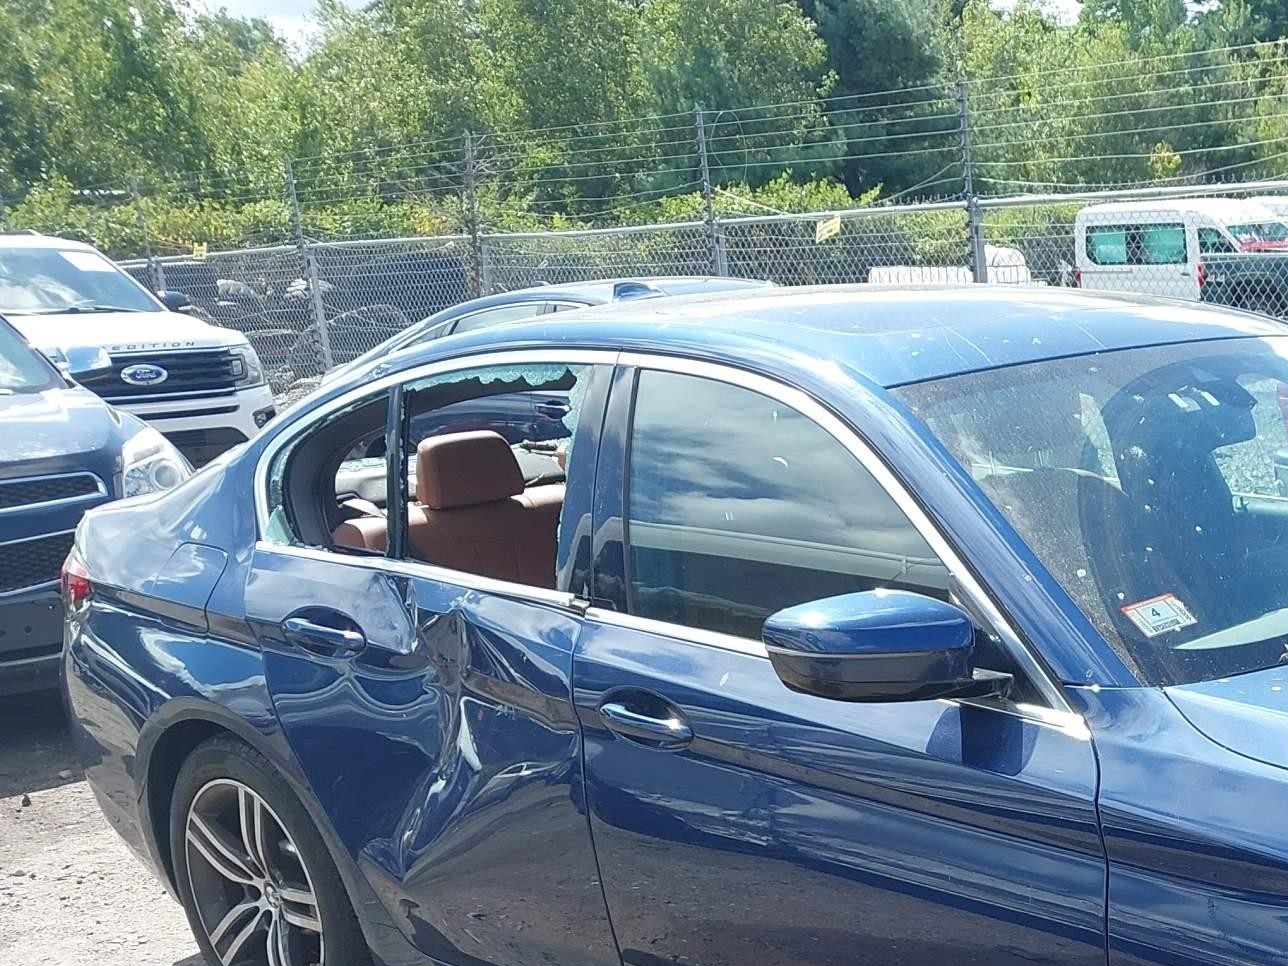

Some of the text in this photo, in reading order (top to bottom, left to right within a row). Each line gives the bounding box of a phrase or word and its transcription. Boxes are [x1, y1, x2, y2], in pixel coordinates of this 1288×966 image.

[102, 341, 194, 351] EDITION
[136, 369, 157, 379] Ford
[1151, 607, 1161, 617] 4
